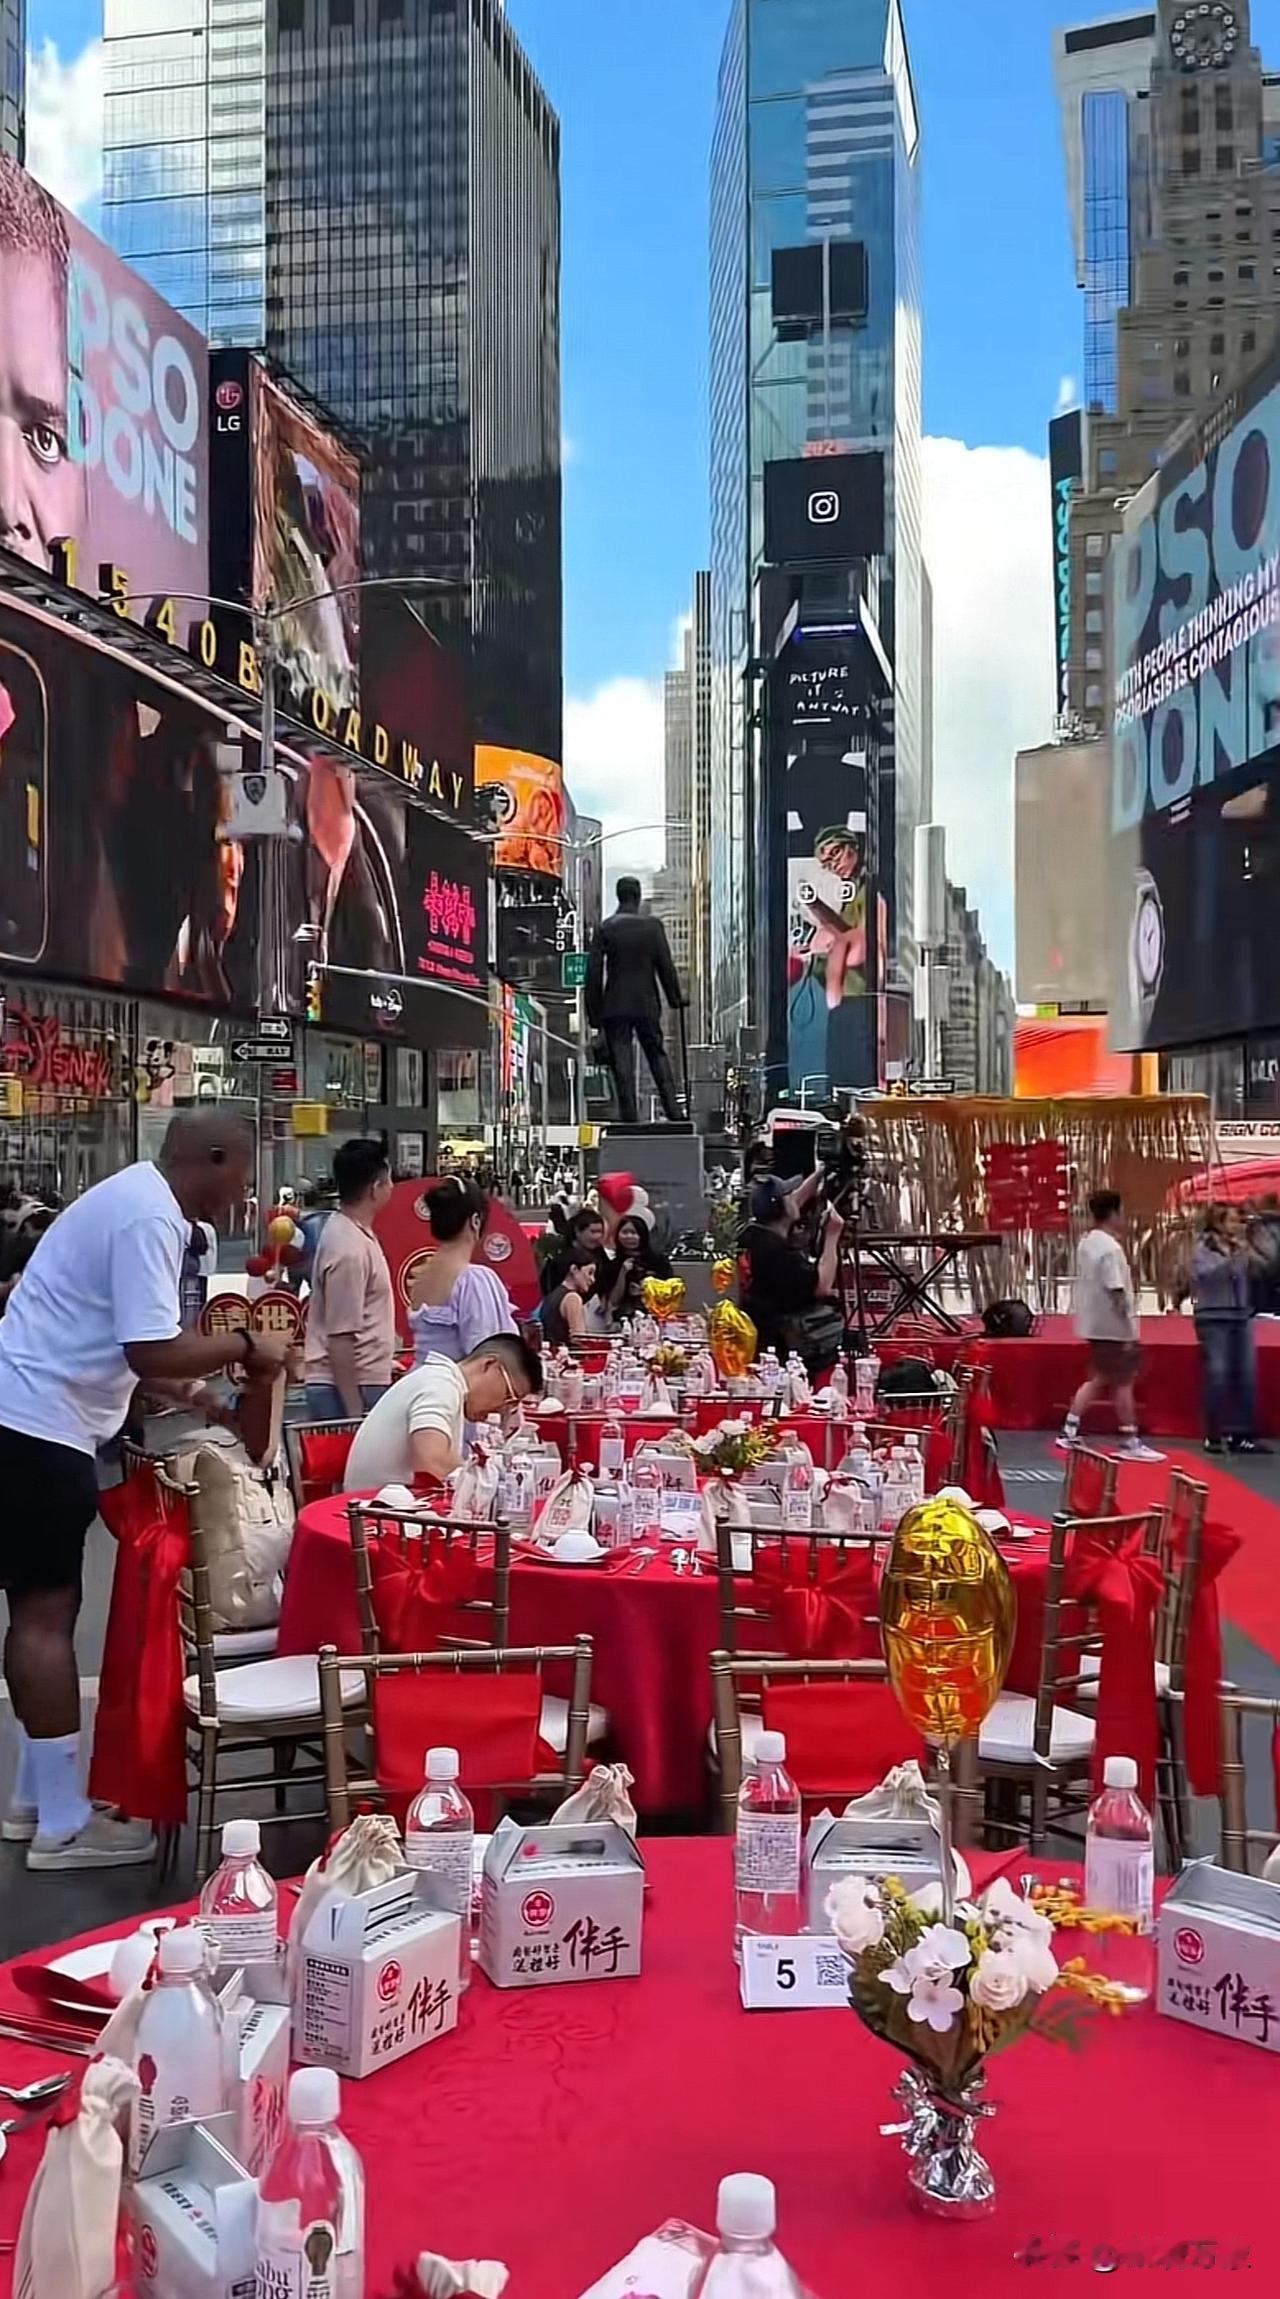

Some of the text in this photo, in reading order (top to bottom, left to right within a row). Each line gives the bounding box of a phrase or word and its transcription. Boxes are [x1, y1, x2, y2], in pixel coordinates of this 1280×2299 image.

[67, 250, 199, 451] PSO
[217, 415, 241, 432] LG
[67, 375, 198, 544] DONE
[1143, 628, 1185, 684] PEOPLE
[1187, 575, 1255, 647] THINKING
[1257, 554, 1280, 597] MY
[788, 665, 848, 686] PICTURE
[807, 683, 822, 697] IT
[1114, 669, 1173, 736] PSORIASIS
[1174, 661, 1188, 692] IS
[239, 639, 464, 809] BOADWAY
[1218, 1123, 1257, 1137] SIGN
[776, 1958, 796, 1989] 5
